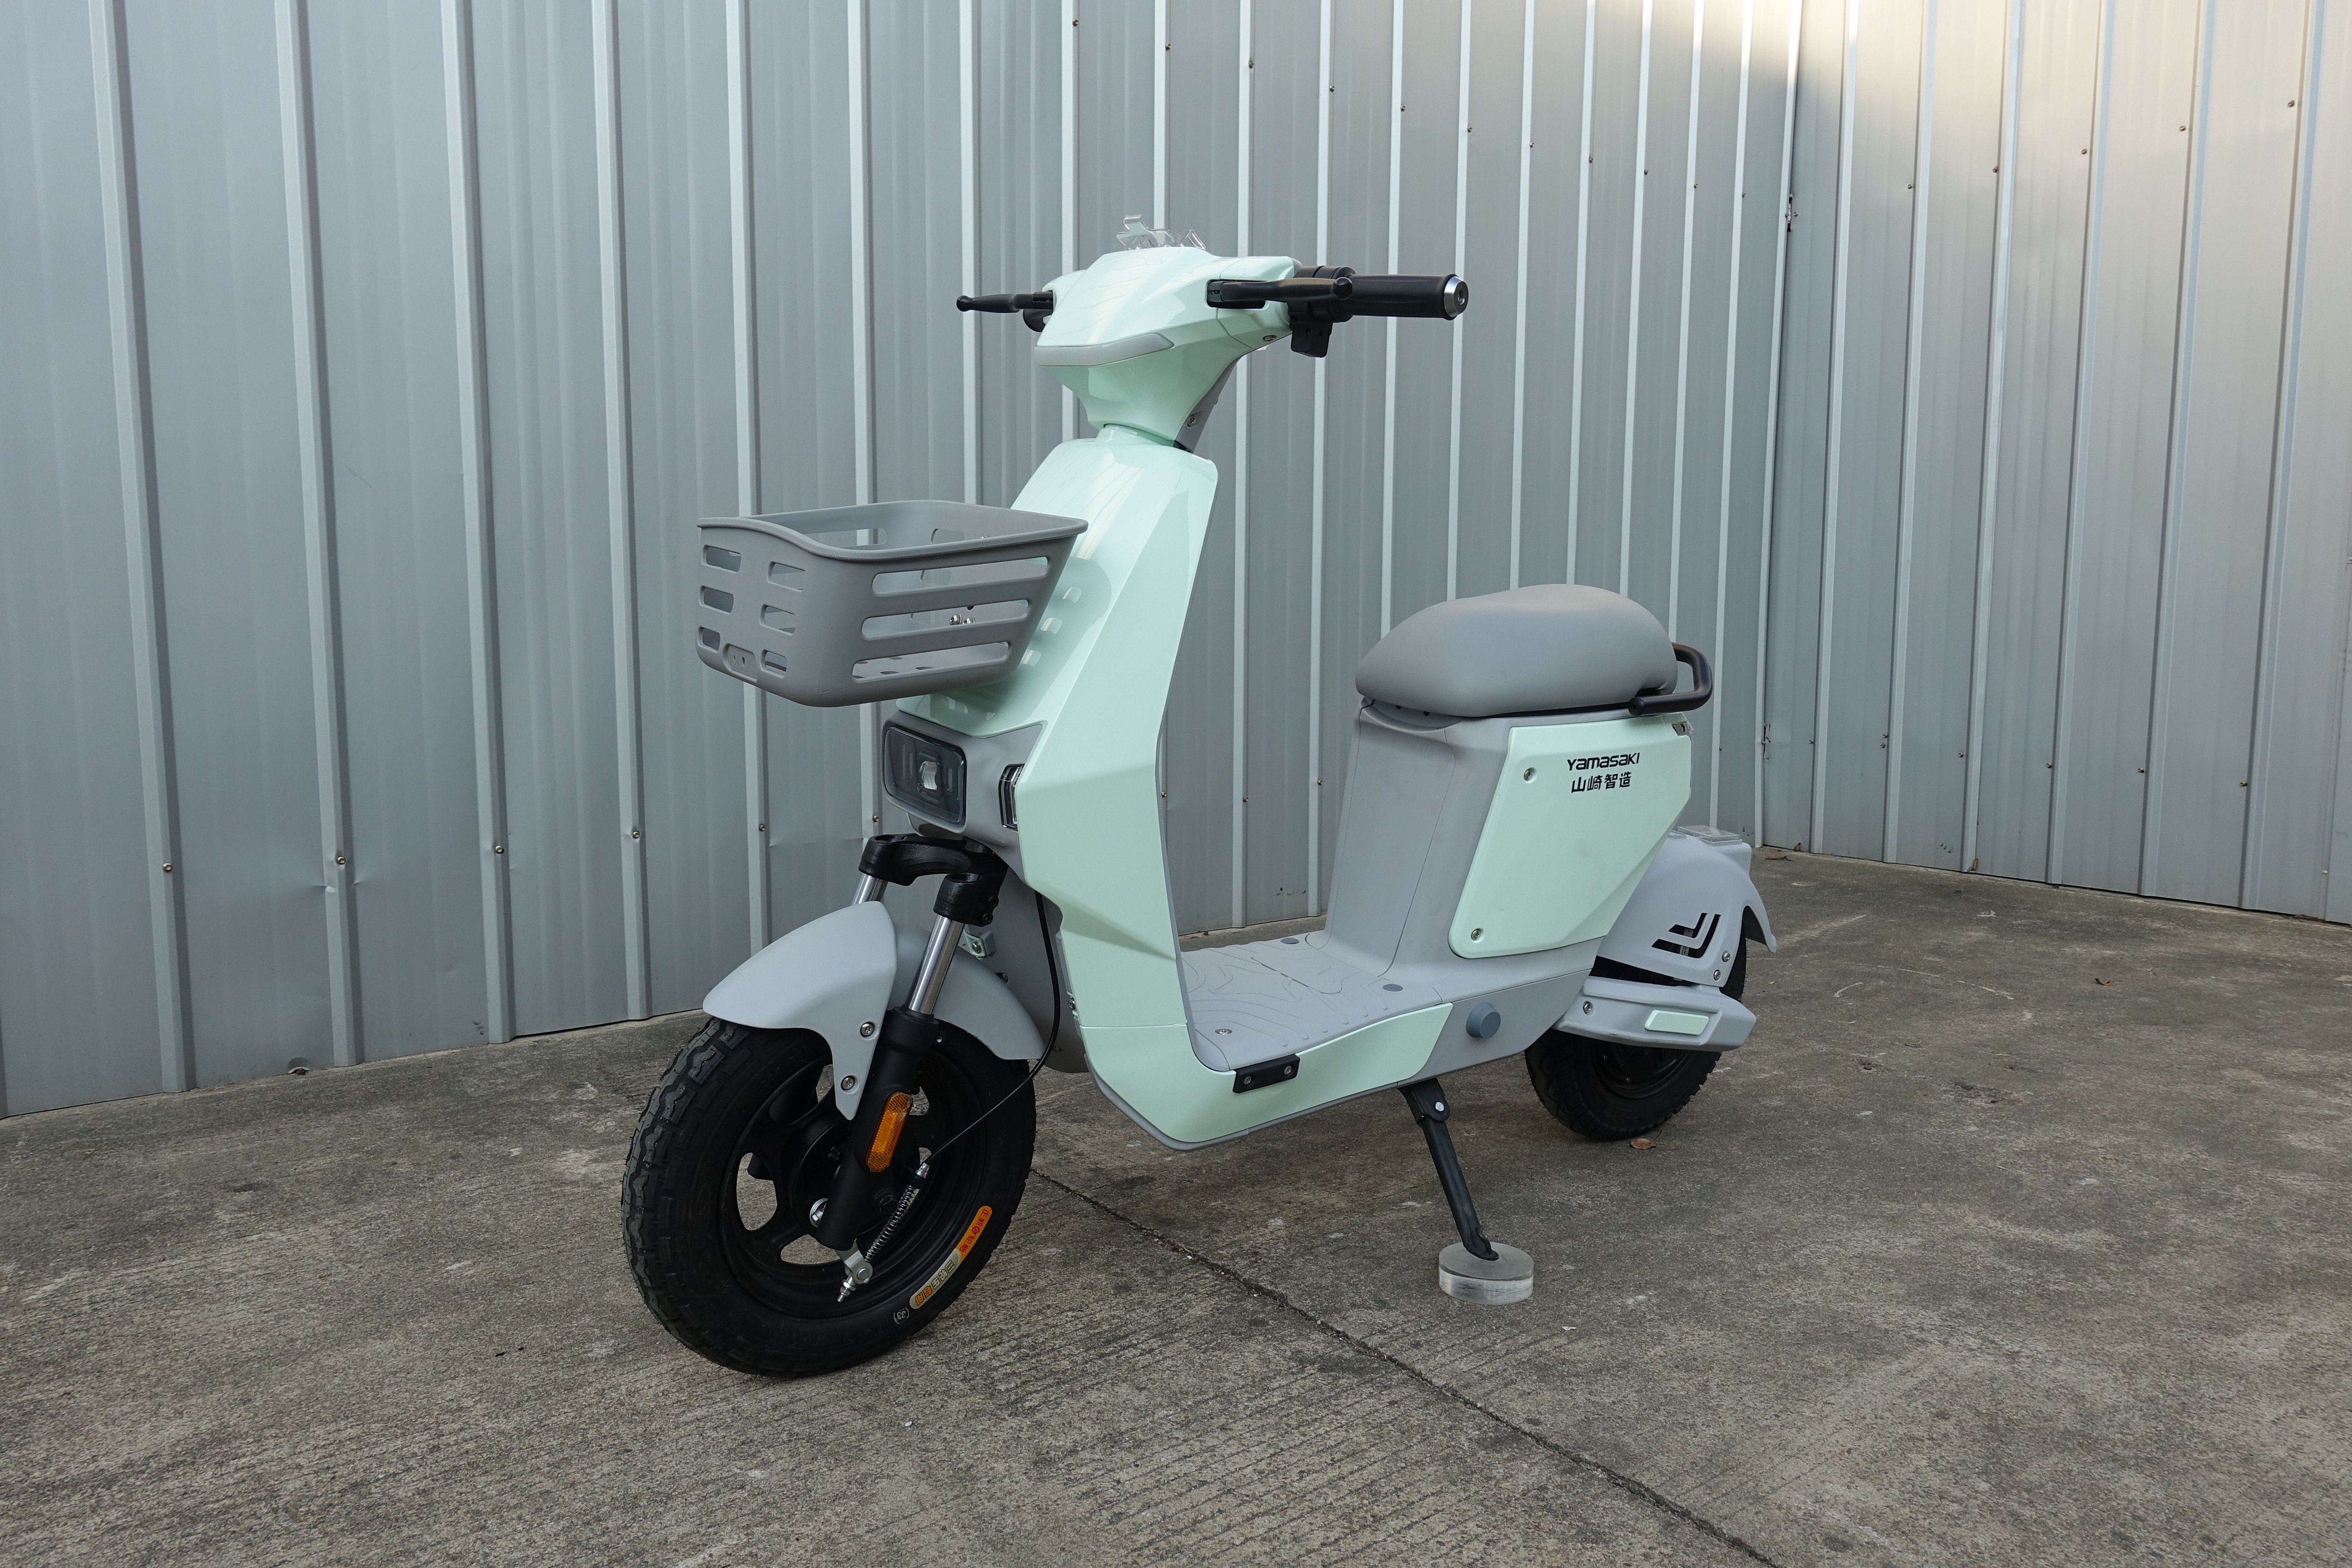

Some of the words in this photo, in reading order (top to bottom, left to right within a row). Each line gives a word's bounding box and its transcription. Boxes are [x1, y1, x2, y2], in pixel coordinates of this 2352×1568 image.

[1571, 771, 1632, 794] 山崎智造
[914, 1259, 956, 1306] 三轮车专用
